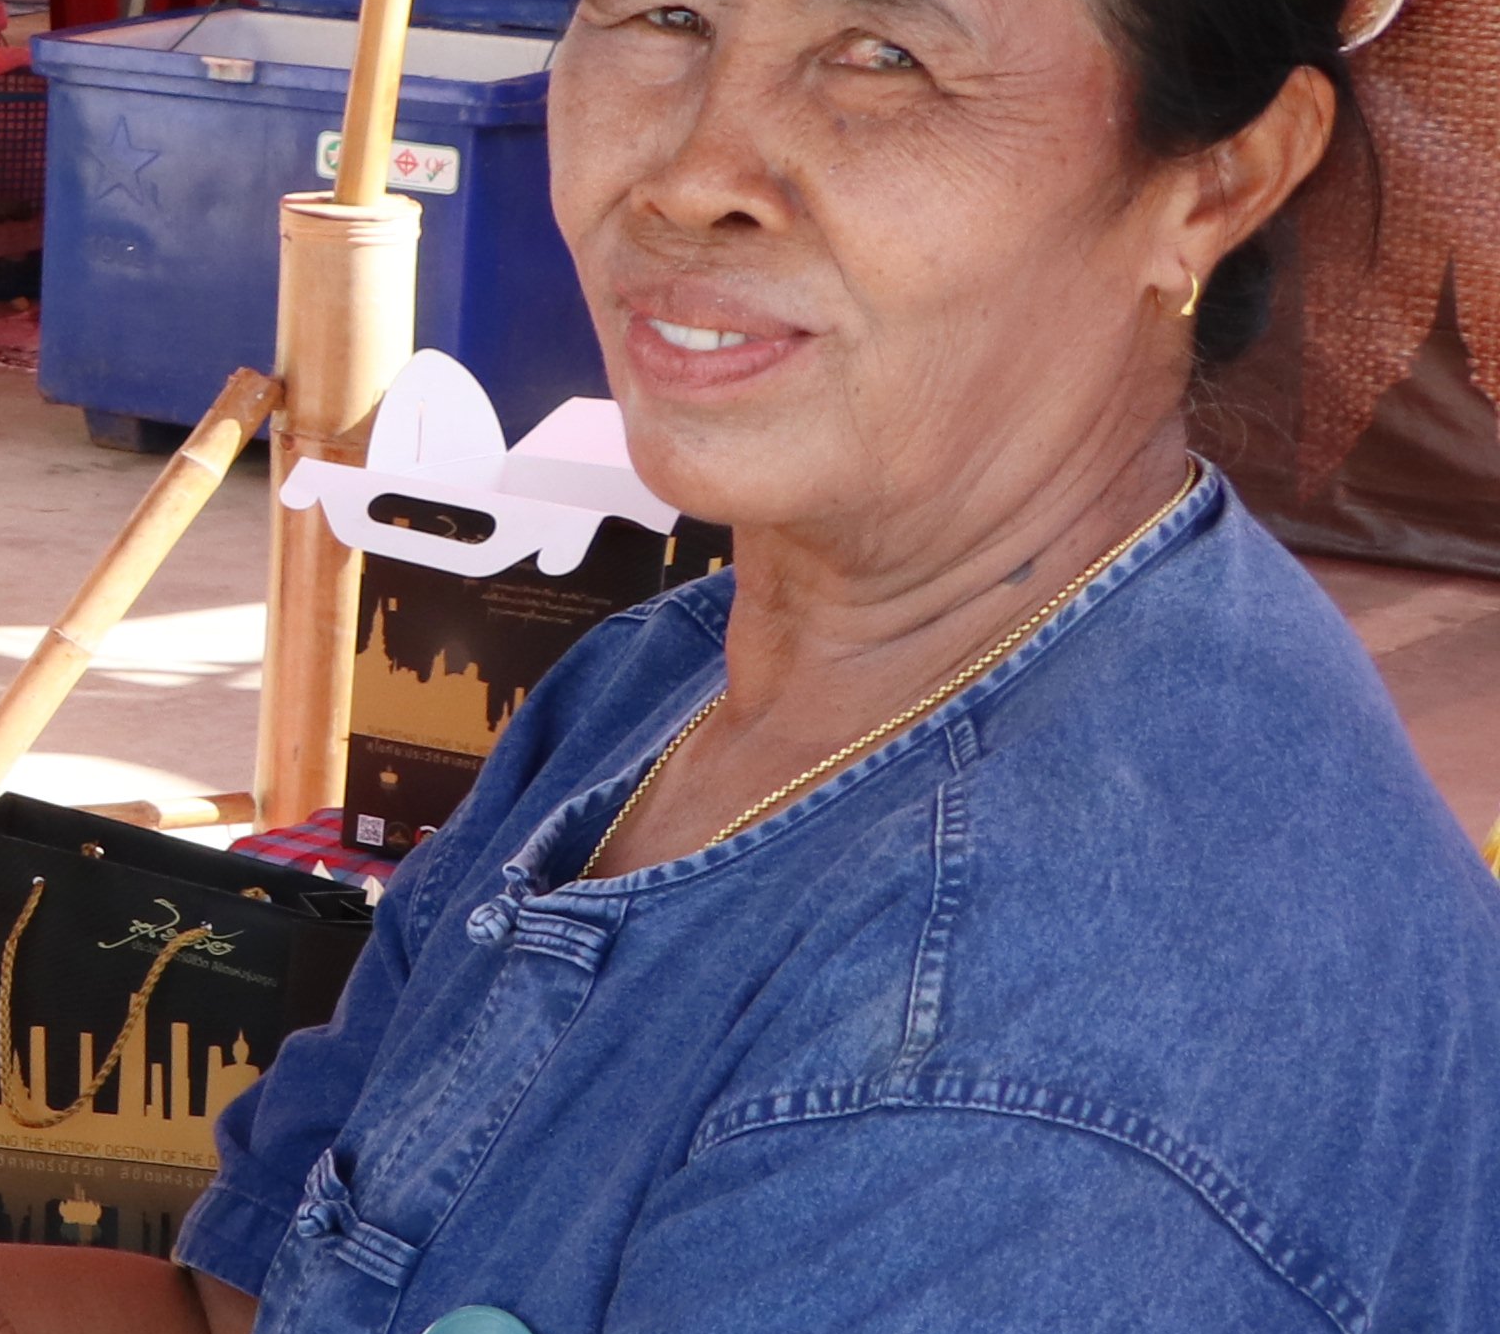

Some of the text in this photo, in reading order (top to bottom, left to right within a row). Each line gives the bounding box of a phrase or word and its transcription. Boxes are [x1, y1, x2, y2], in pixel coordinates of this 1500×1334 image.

[22, 1134, 46, 1149] THE
[105, 1143, 156, 1160] DESTINY
[161, 1148, 178, 1163] OF
[182, 1150, 205, 1165] THE
